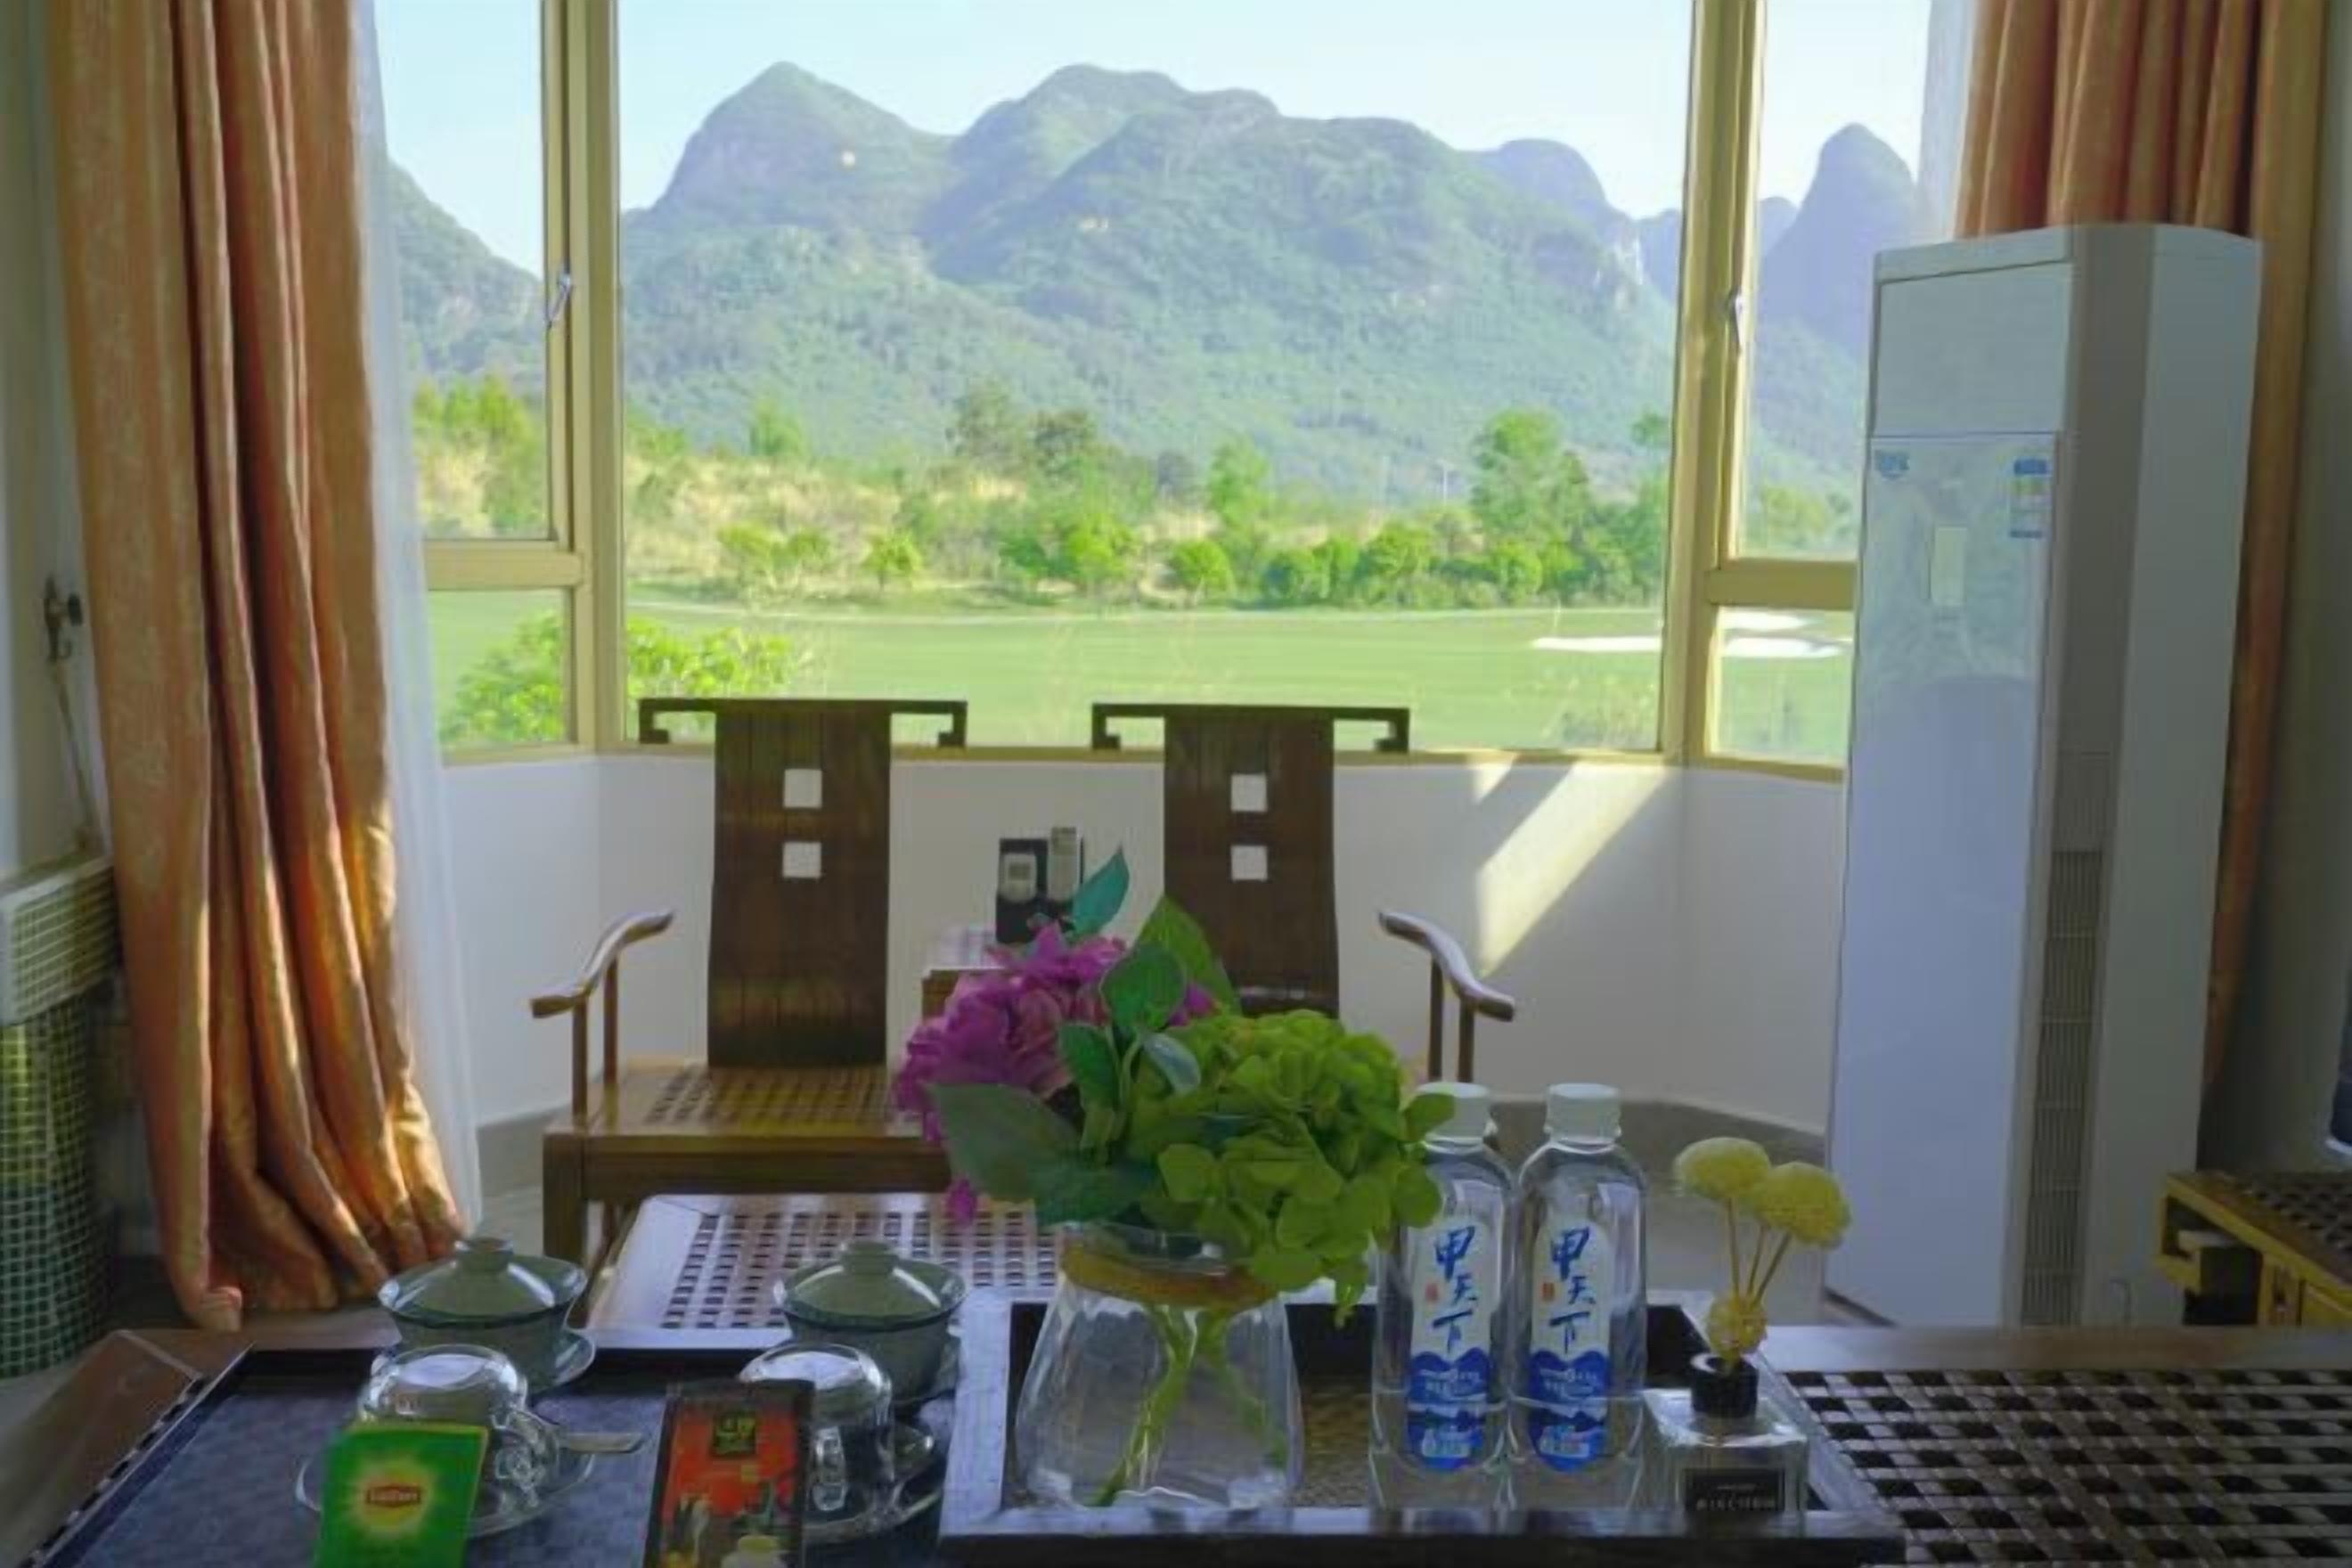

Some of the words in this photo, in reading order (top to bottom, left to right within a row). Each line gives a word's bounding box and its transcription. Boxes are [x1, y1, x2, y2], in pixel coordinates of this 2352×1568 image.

[1433, 1225, 1477, 1354] 甲天下
[1549, 1226, 1597, 1355] 甲天下
